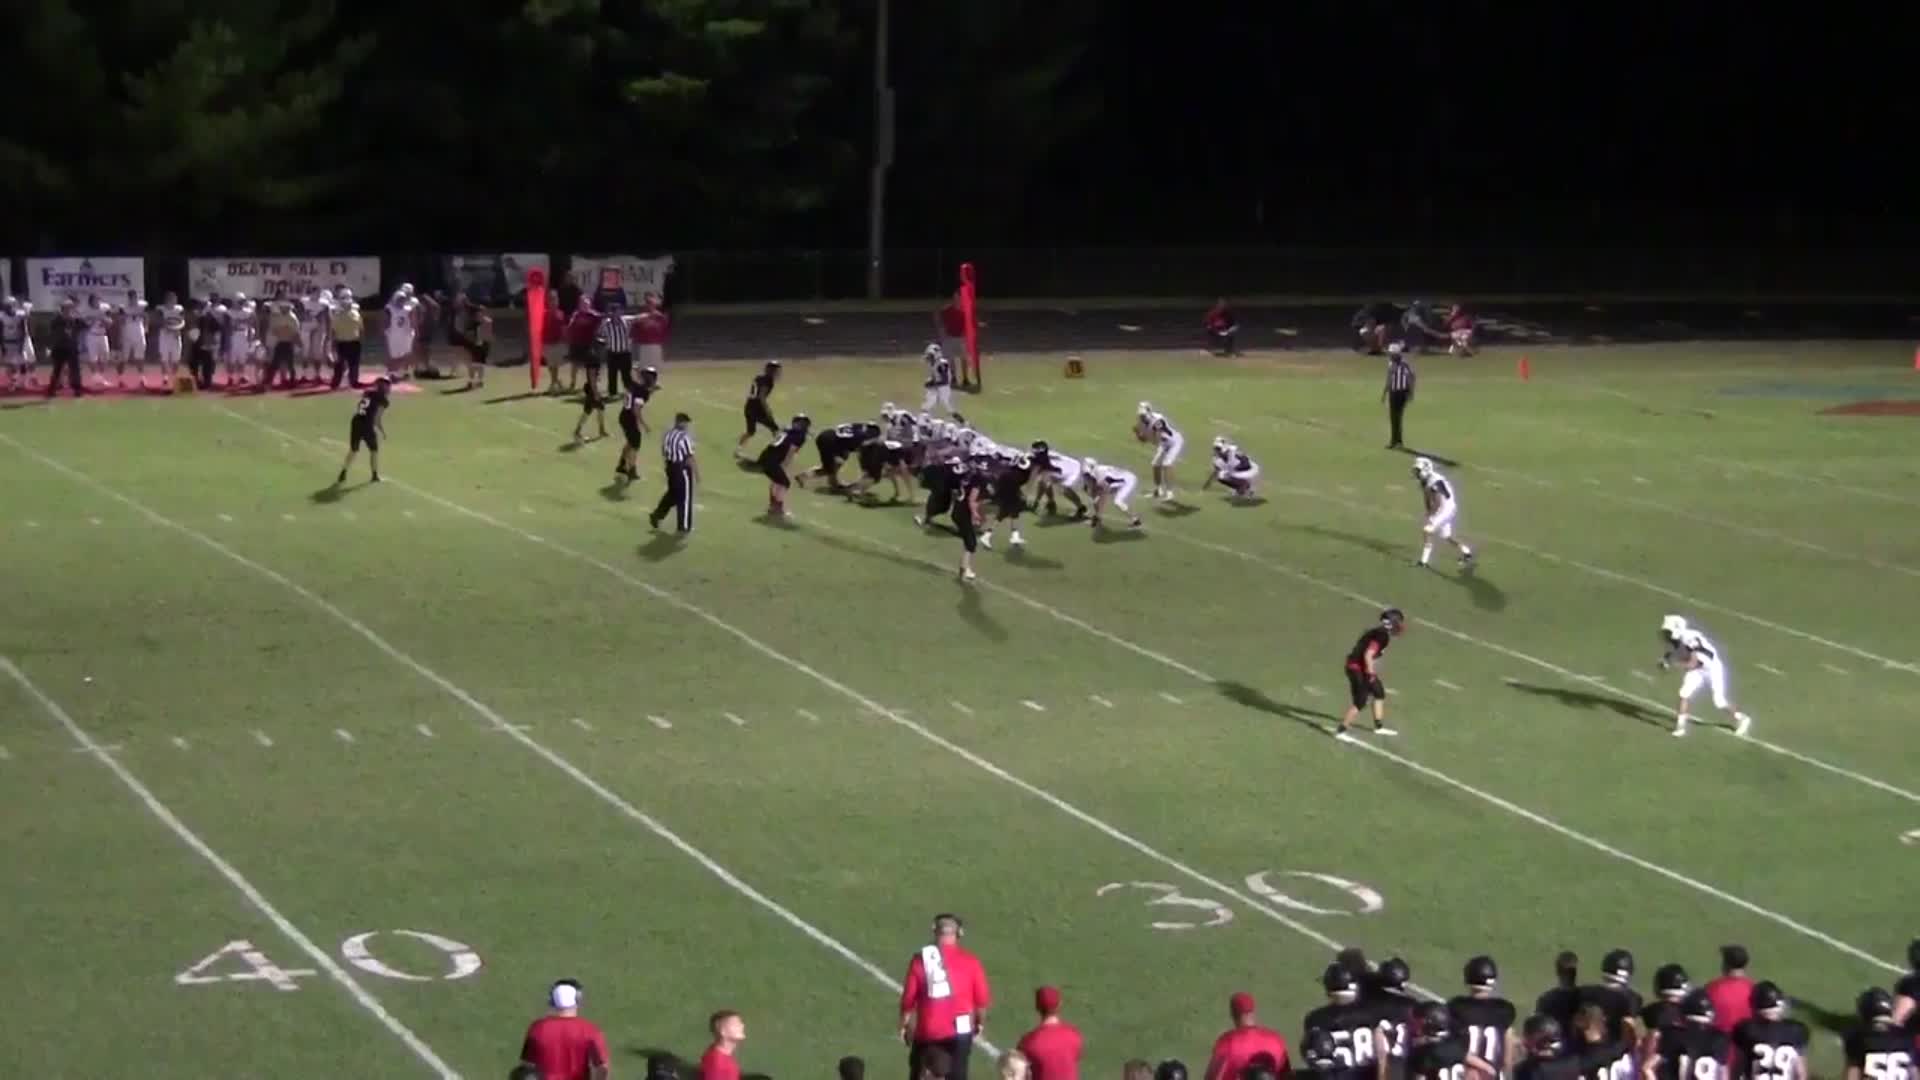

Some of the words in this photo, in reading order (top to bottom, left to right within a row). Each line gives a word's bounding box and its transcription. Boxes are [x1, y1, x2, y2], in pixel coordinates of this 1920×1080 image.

[41, 267, 131, 286] Farmers
[1095, 870, 1384, 929] 30
[174, 929, 482, 991] 40
[1330, 1026, 1373, 1066] 58
[1468, 1025, 1497, 1061] 11
[1864, 1051, 1911, 1080] 56
